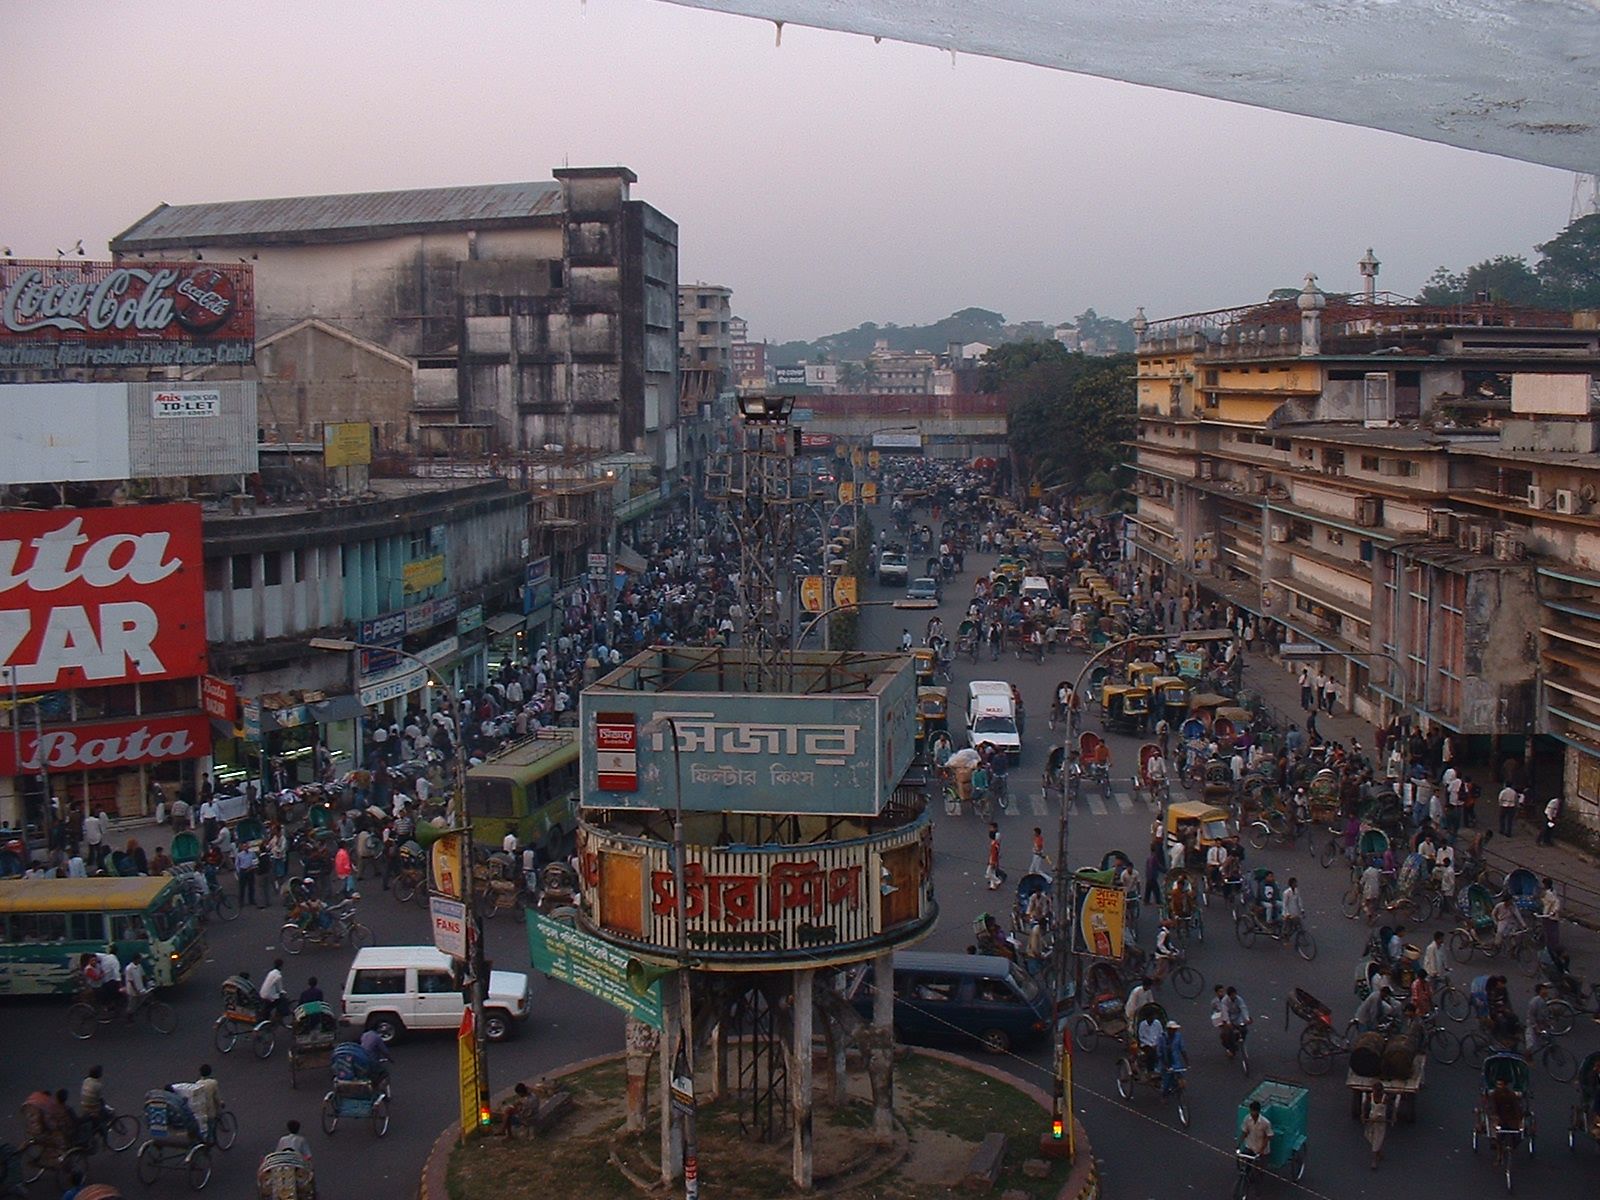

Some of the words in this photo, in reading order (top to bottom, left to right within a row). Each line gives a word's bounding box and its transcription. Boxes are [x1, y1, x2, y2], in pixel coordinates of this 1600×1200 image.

[3, 268, 180, 332] Coca-Cola
[177, 278, 230, 316] Coca-Cola
[57, 345, 142, 364] Refreshes
[161, 401, 215, 411] TO-LET
[375, 683, 406, 701] HOTEL
[22, 726, 194, 769] Bata
[652, 711, 861, 765] সিজার
[690, 762, 757, 786] ফিল্টার
[769, 762, 815, 786] কিংস
[436, 917, 461, 934] FANS
